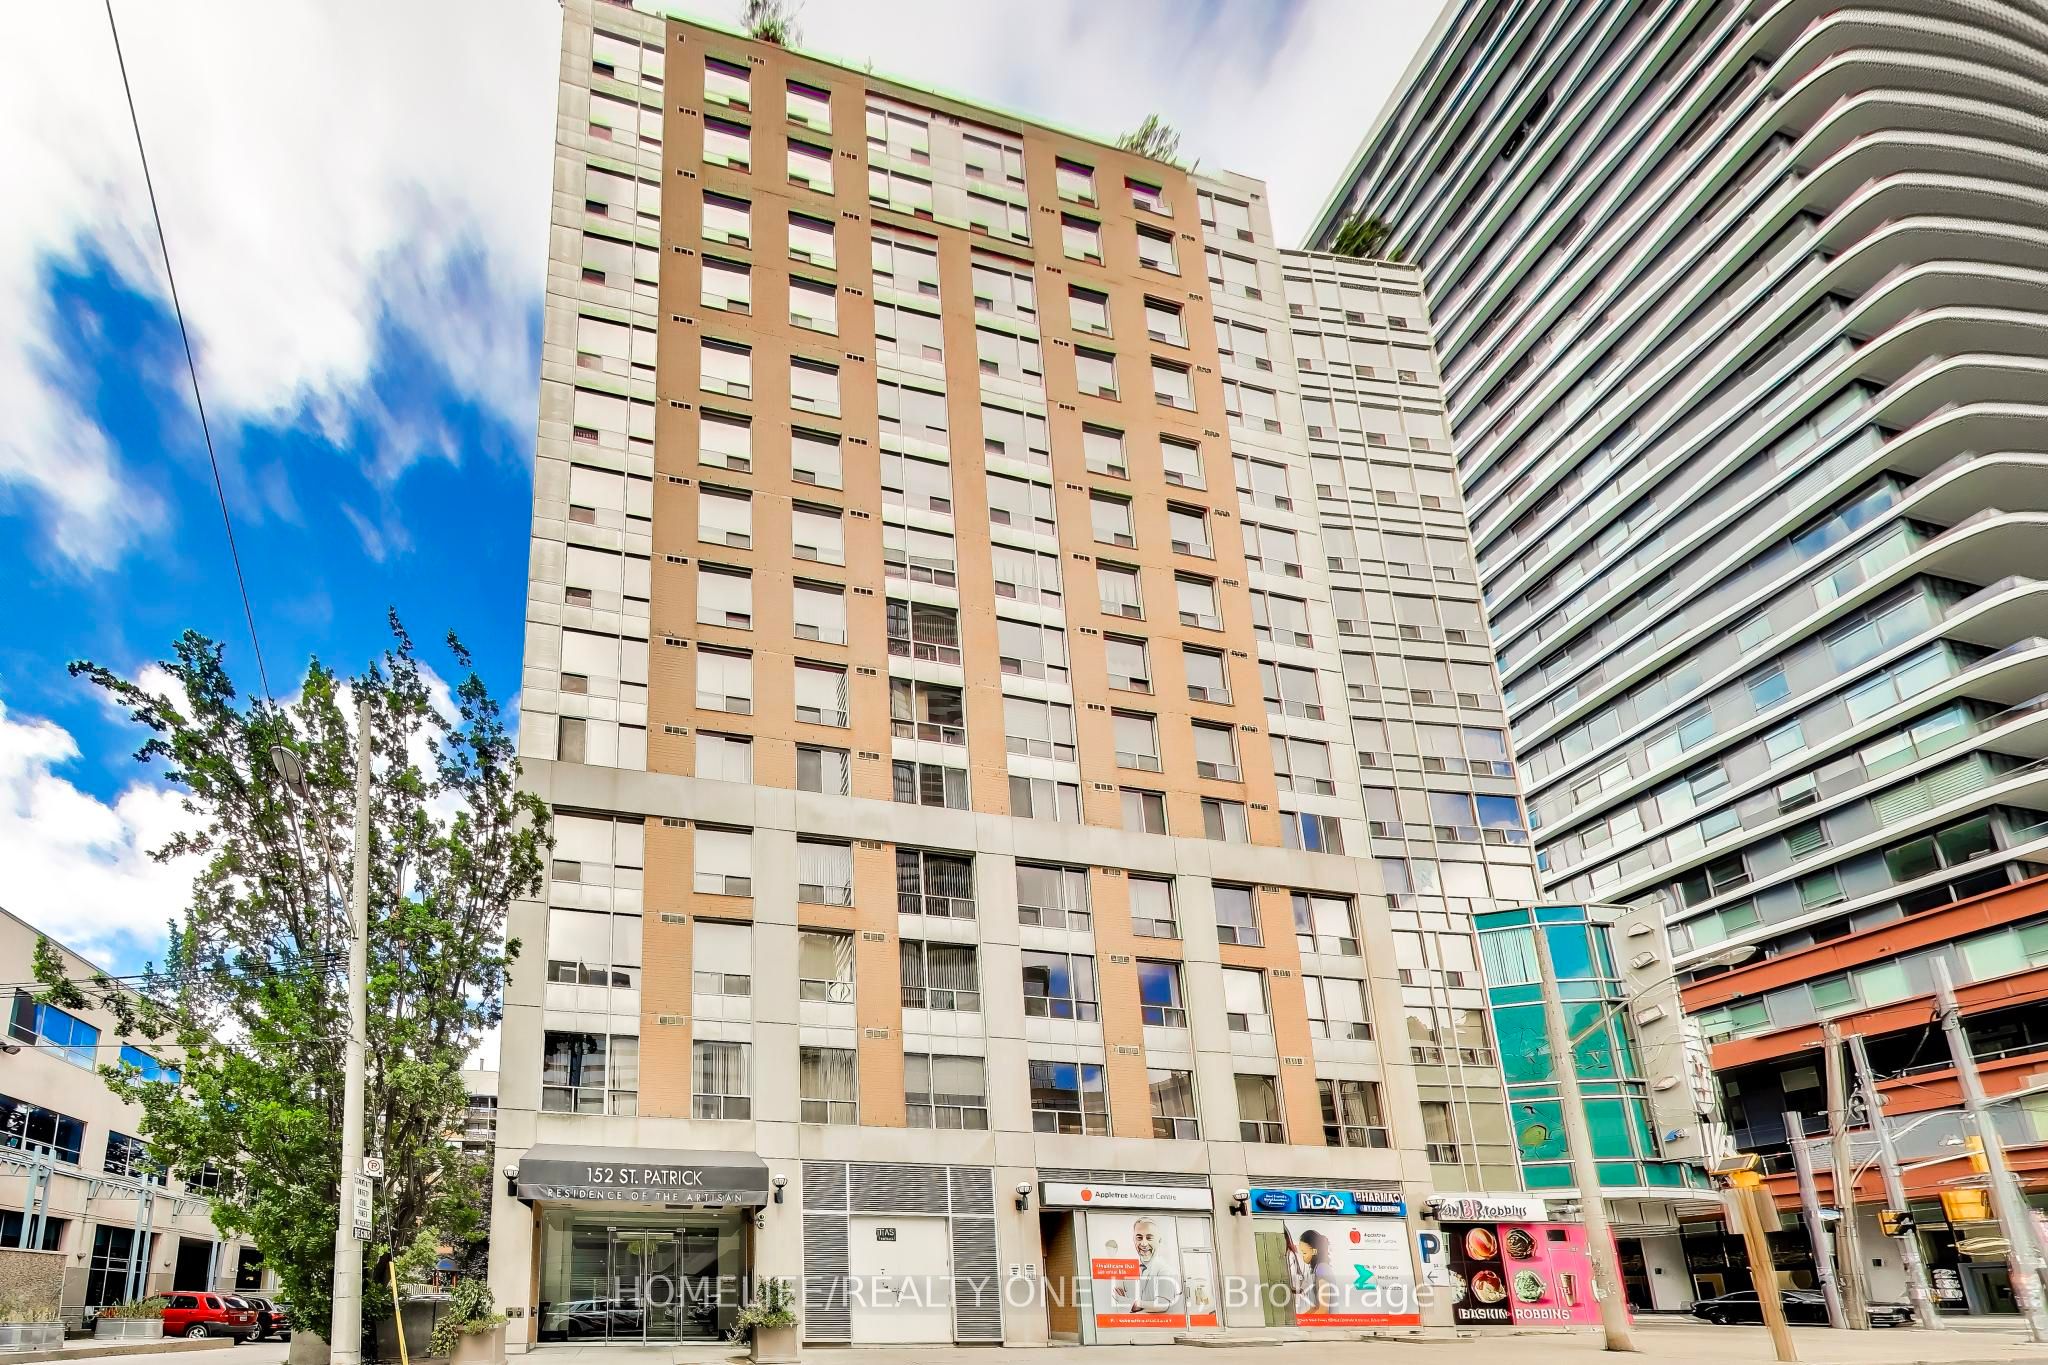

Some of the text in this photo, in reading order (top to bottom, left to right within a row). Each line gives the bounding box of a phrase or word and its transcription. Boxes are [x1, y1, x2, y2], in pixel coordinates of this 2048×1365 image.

[587, 1168, 703, 1187] 152 ST. PATRICK
[547, 1188, 744, 1203] RESIDENCE OF THE ARTISAN
[1095, 1191, 1177, 1201] Appletree Medical Centre
[1420, 1233, 1441, 1264] P
[1458, 1308, 1571, 1320] BASKIN ROBBINS
